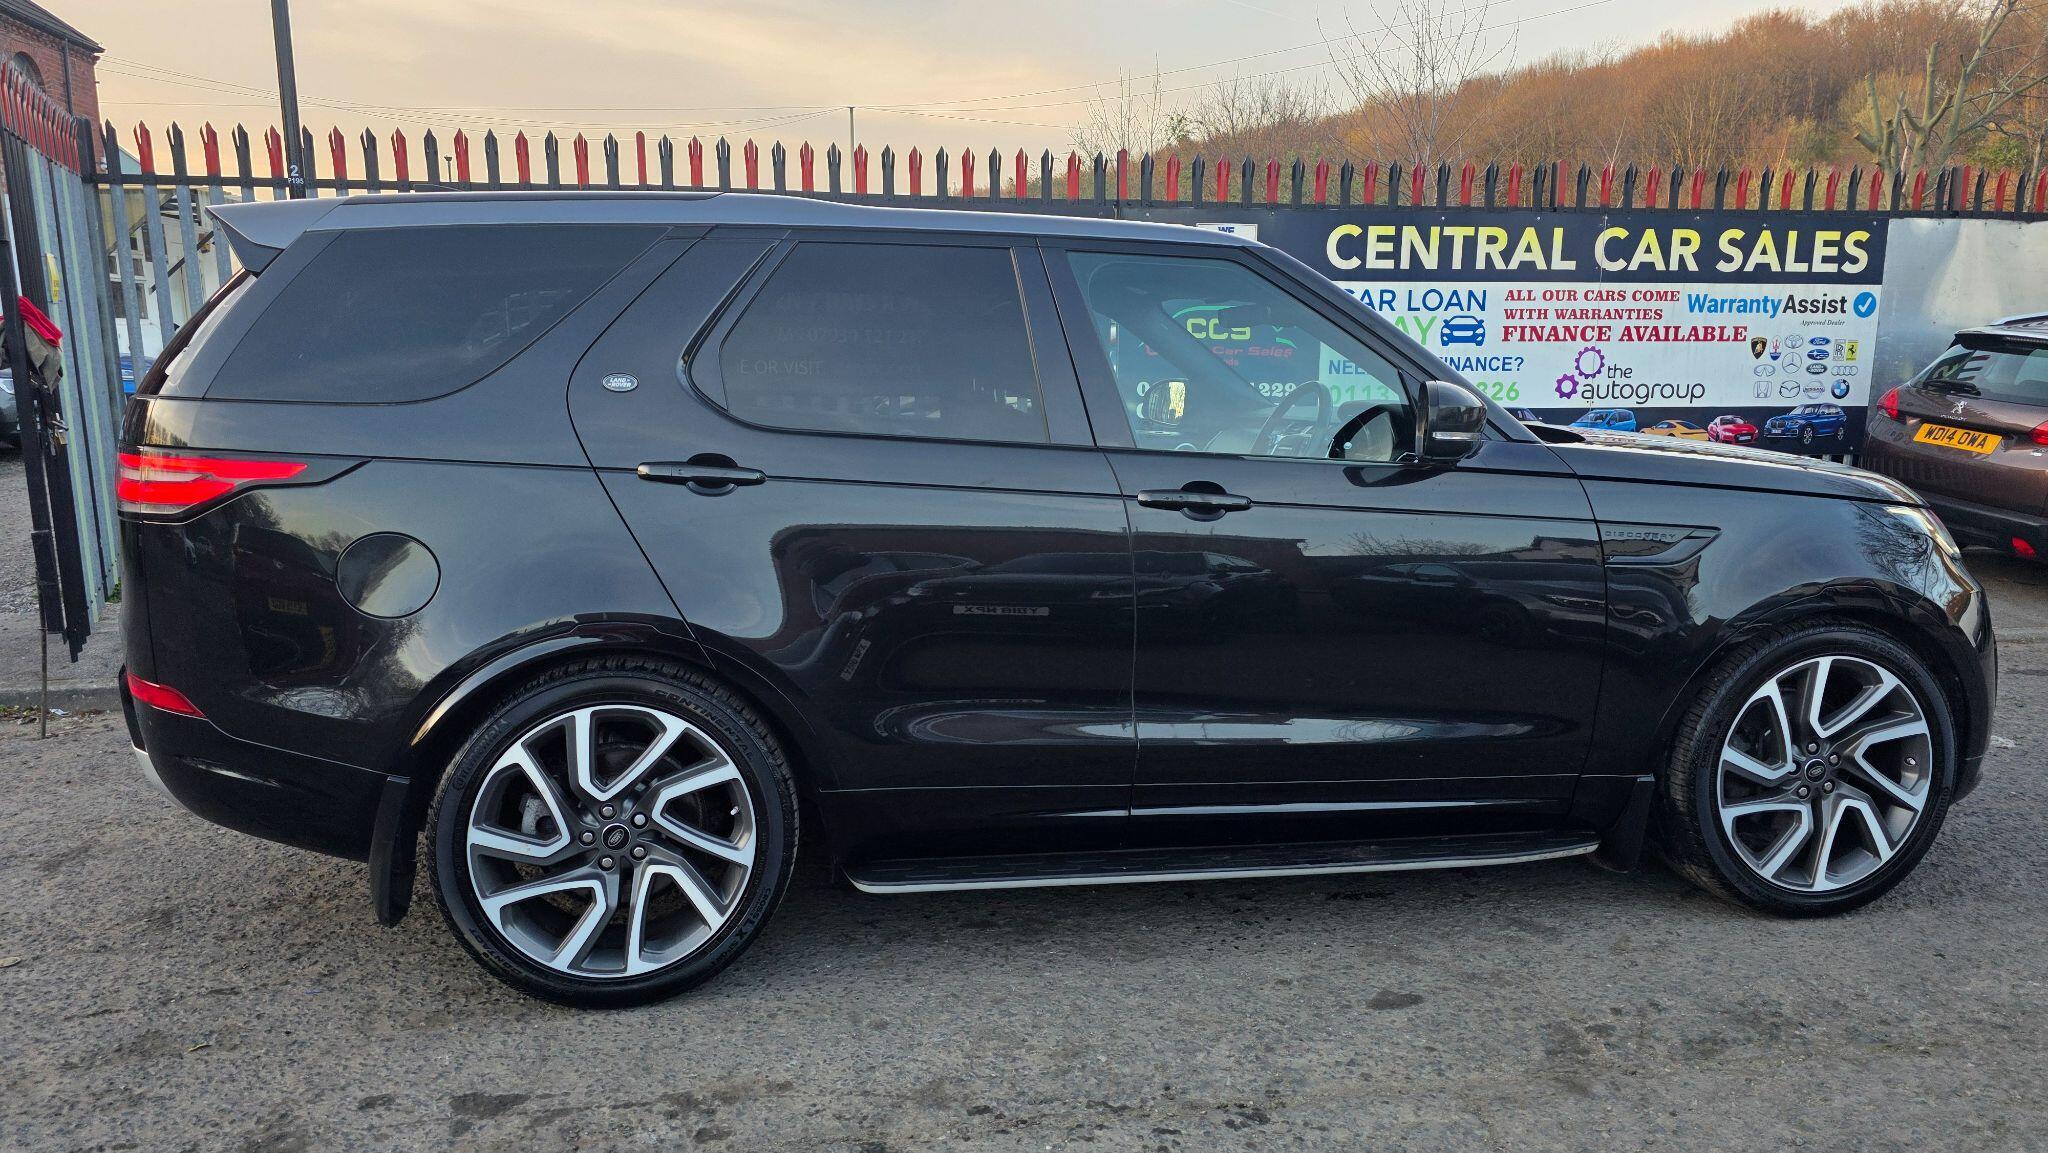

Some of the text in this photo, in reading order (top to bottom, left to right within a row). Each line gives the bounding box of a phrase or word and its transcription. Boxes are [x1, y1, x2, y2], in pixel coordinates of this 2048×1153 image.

[289, 164, 299, 177] 2
[1325, 224, 1871, 274] CENTRAL CAR SALES
[1344, 288, 1487, 312] AR LOAN
[1504, 289, 1681, 302] ALL OUR CARS COME
[1503, 308, 1664, 320] WITH WARRANTIES
[1687, 293, 1848, 319] WarrantyAssist
[1501, 325, 1749, 343] FINANCE AVAILABLE
[1211, 345, 1293, 357] Car Sales
[753, 360, 778, 376] OR
[782, 360, 825, 376] VISIT
[1438, 356, 1525, 372] NANCE?
[1607, 363, 1633, 379] the
[1249, 382, 1298, 398] 229
[1580, 381, 1706, 405] autogroup
[1923, 426, 1988, 449] WD14 OWA
[1604, 530, 1677, 540] DISCOVERY
